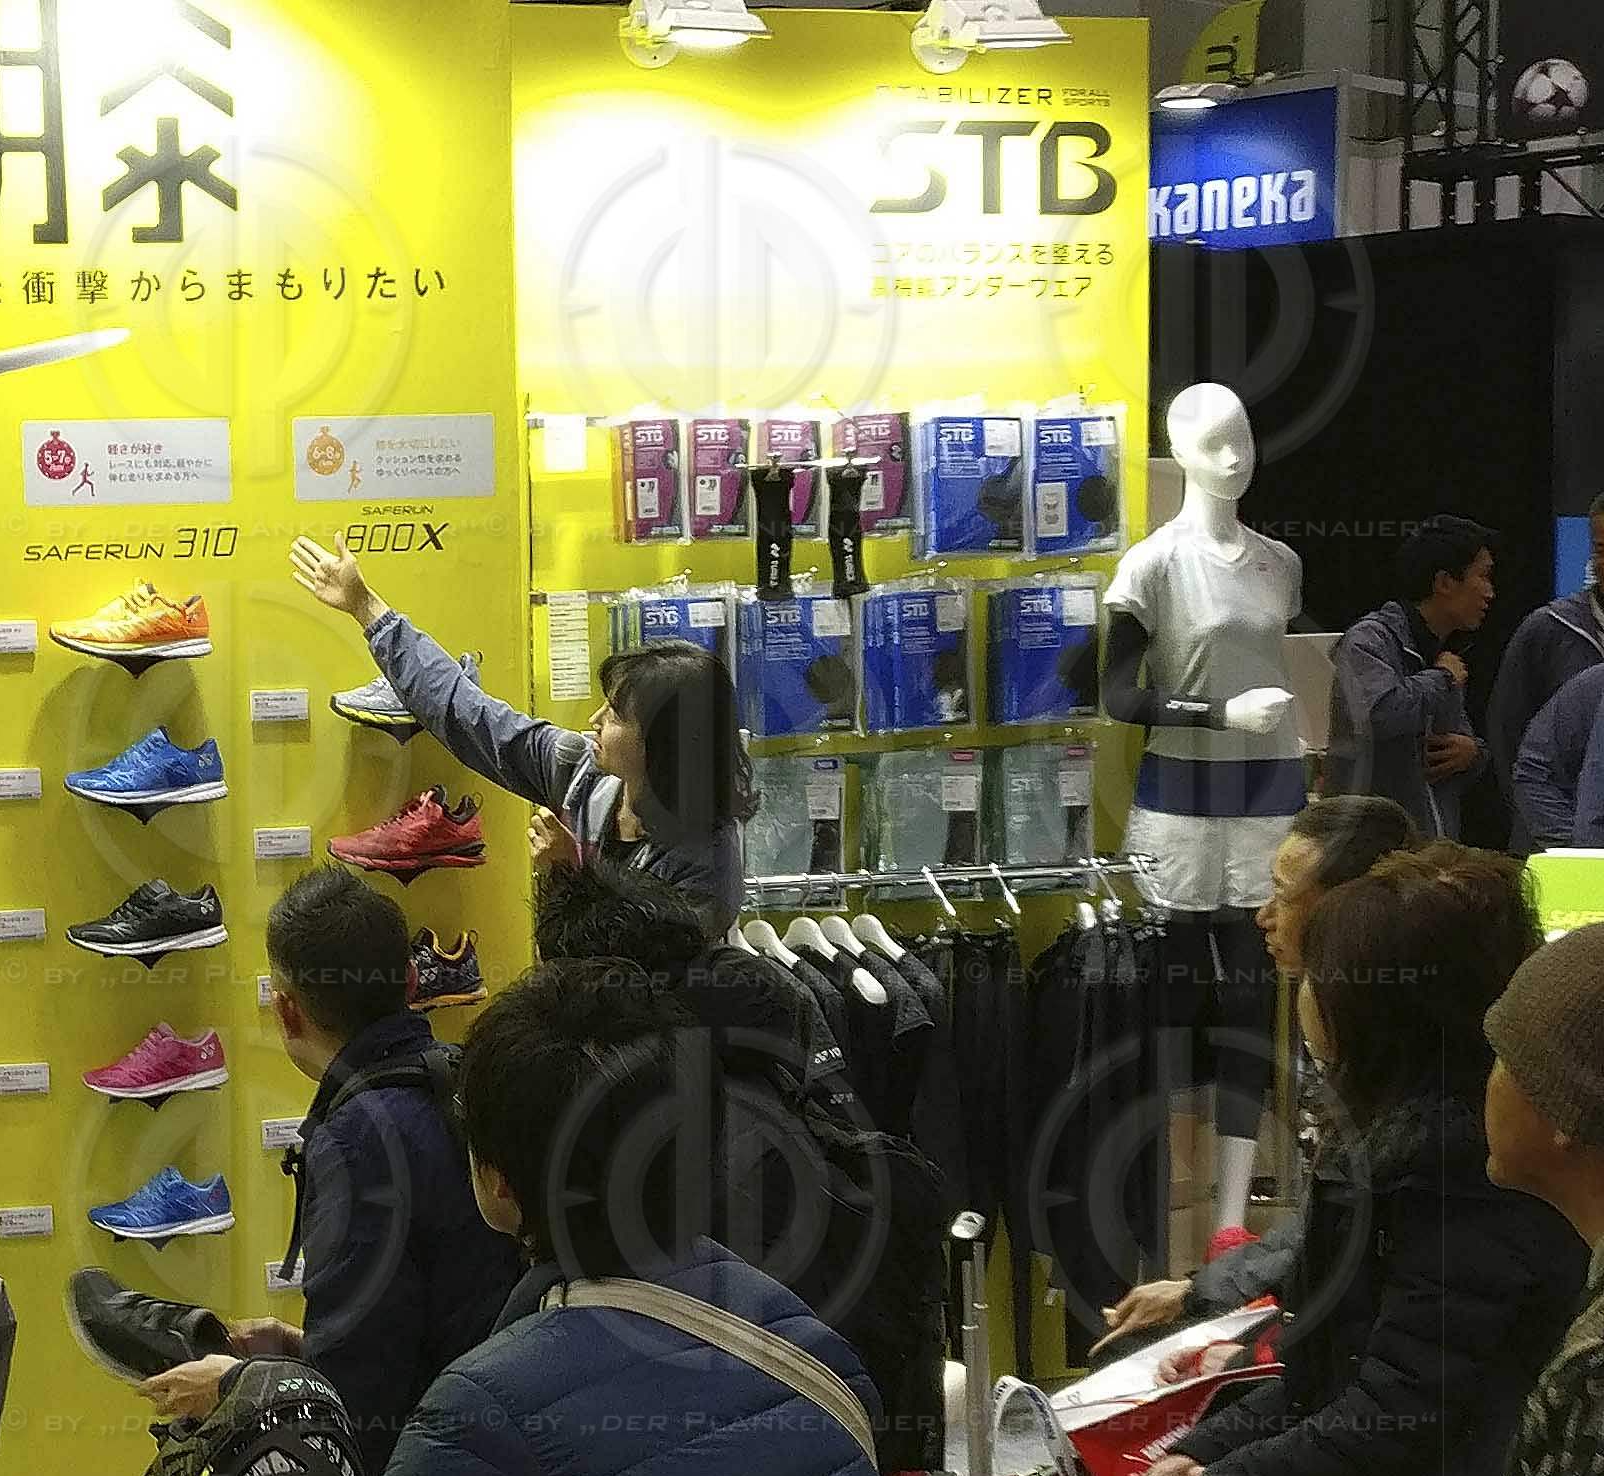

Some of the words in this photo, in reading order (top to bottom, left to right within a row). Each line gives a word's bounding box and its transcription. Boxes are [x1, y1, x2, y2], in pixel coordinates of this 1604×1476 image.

[869, 120, 1118, 216] STB
[360, 504, 435, 517] SAFERUN
[23, 542, 165, 562] SAFERUN
[172, 526, 239, 558] 310
